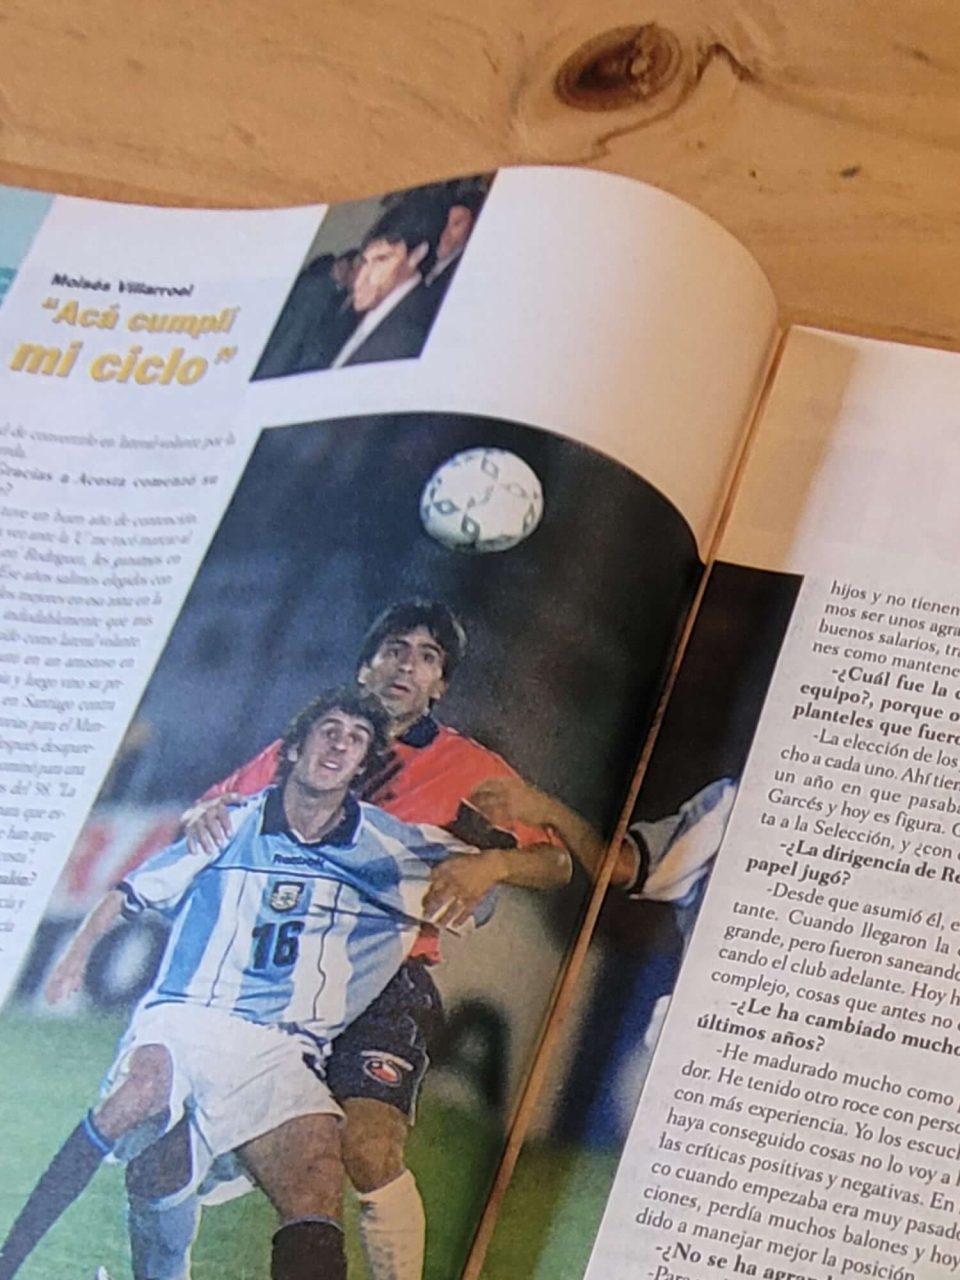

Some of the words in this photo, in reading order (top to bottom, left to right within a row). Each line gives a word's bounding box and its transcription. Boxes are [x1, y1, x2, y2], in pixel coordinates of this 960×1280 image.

[51, 273, 111, 293] Moisés
[118, 279, 195, 298] Villarroel
[127, 305, 241, 339] cumplí
[9, 340, 84, 379] mi
[831, 665, 892, 688] -¿Cuál
[895, 673, 926, 694] fue
[930, 679, 949, 698] la
[791, 700, 875, 730] planteles
[878, 720, 914, 738] que
[799, 683, 875, 710] equipo?,
[878, 698, 945, 721] porque
[252, 920, 305, 970] 16
